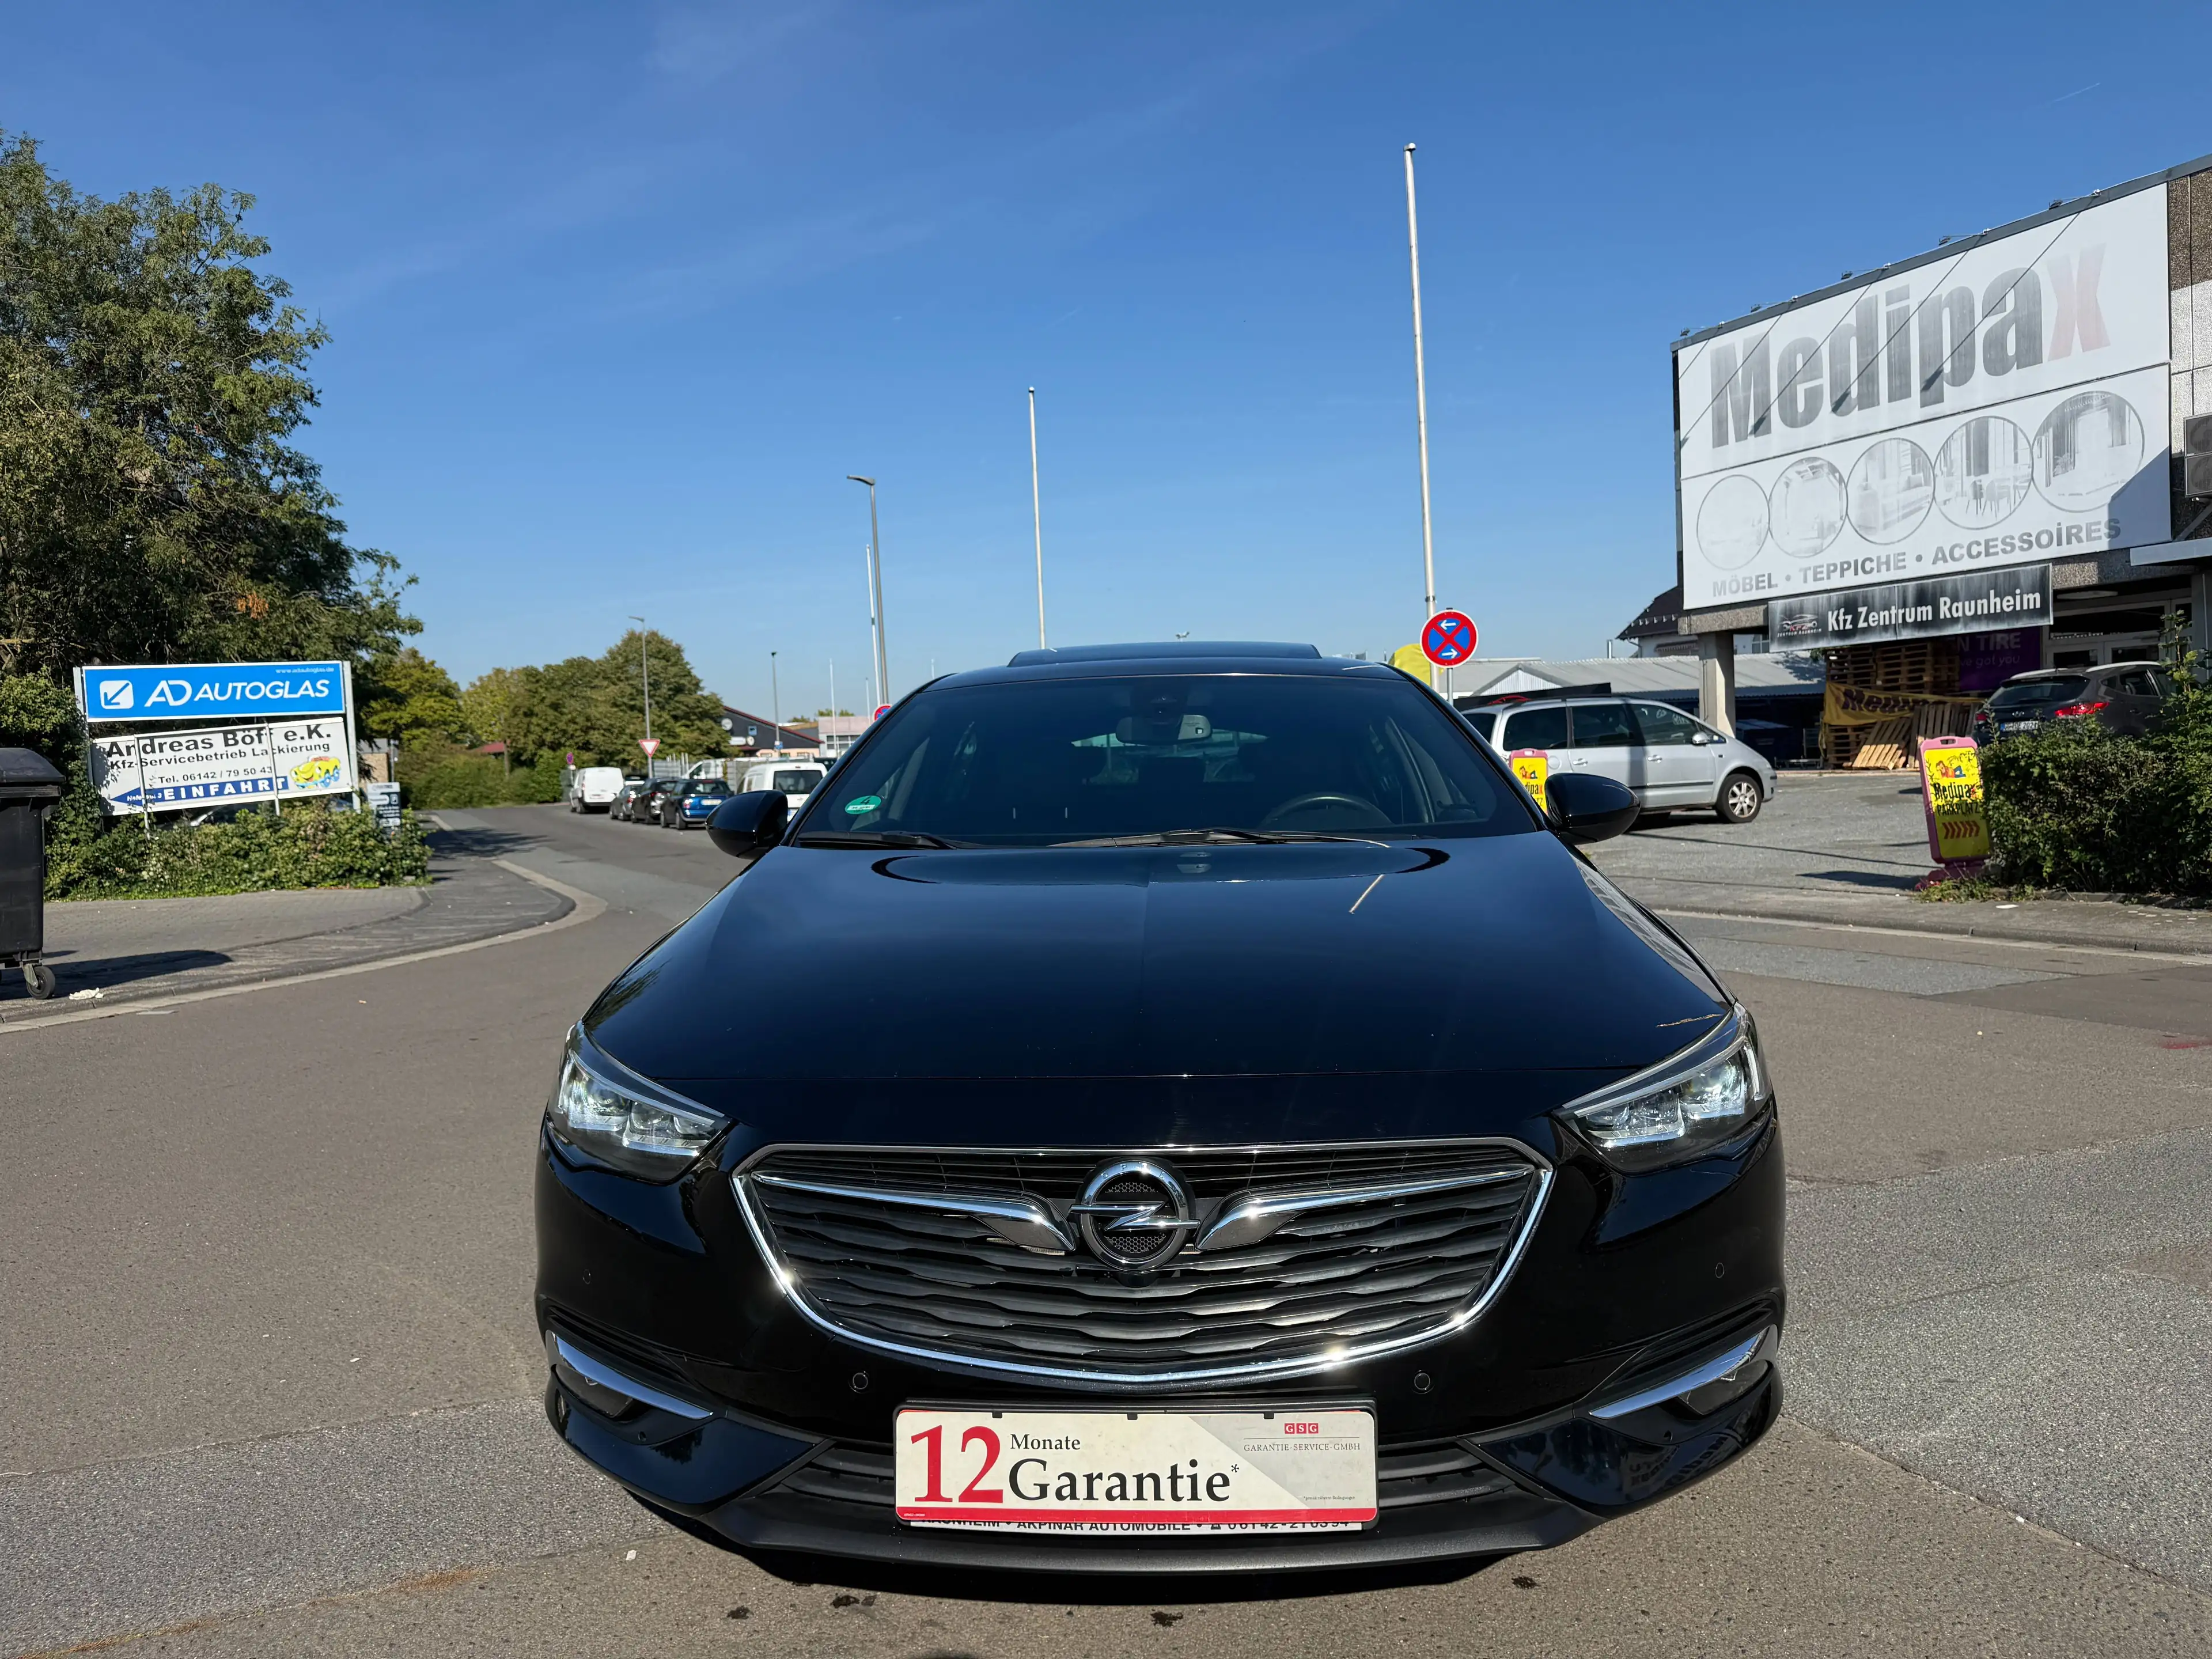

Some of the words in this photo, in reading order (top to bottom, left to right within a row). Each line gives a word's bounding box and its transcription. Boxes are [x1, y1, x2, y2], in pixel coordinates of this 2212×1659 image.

[1710, 243, 2111, 449] Medipax
[1713, 573, 1778, 597] MÖBEL
[1798, 552, 1907, 584] TEPPICHE
[1828, 608, 1853, 631] Kfz
[1857, 605, 1932, 628] Zentrum
[1940, 588, 2040, 619] Raunheim
[1976, 631, 2021, 652] TIRE
[1998, 655, 2020, 668] you
[144, 680, 192, 707] AD
[194, 679, 330, 701] AUTOGLAS
[284, 724, 331, 741] e.K.
[110, 749, 247, 770] Kfz-Servicebetrieb
[158, 775, 179, 783] Tel.
[183, 771, 216, 781] 06142
[226, 769, 239, 777] 79
[244, 767, 256, 775] 50
[164, 778, 285, 800] EINFAHRT
[861, 797, 872, 805] 4
[1285, 1424, 1318, 1433] GSG
[1244, 1443, 1361, 1452] GARANTIE-SERVICE-GMBH
[911, 1425, 1004, 1503] 12
[1010, 1433, 1081, 1450] Monate
